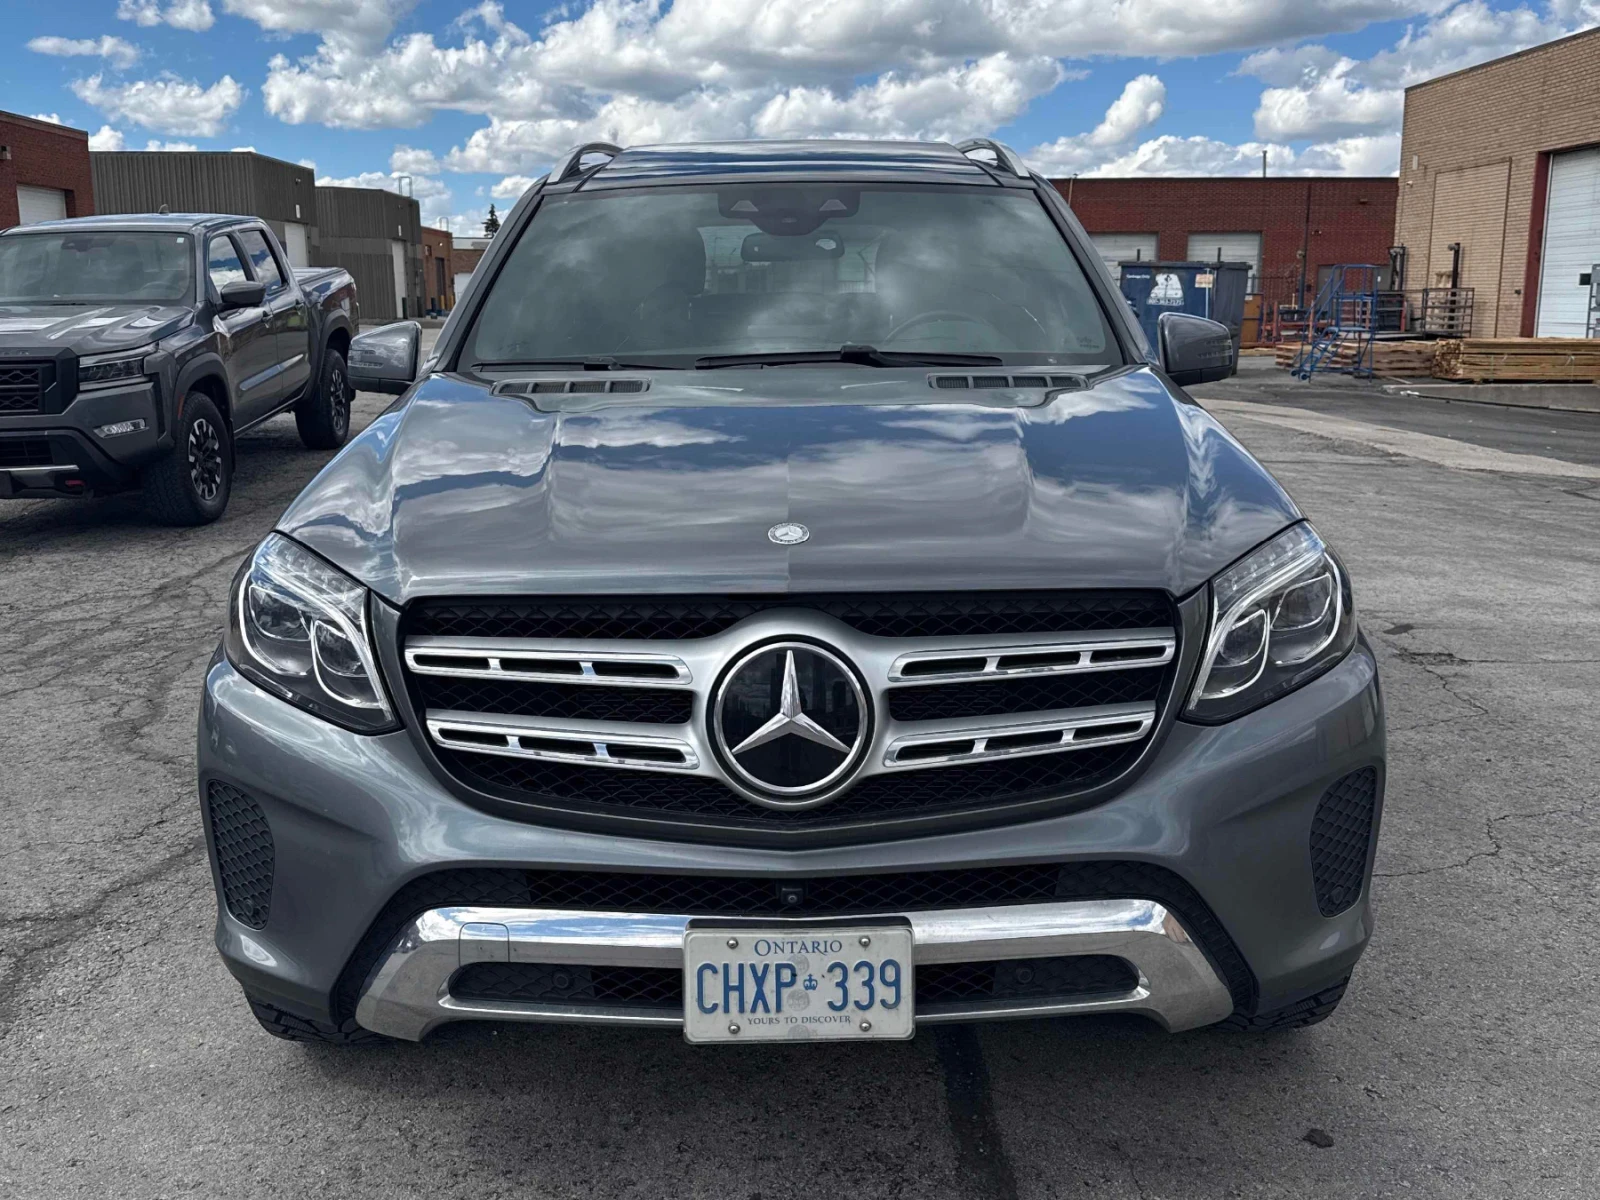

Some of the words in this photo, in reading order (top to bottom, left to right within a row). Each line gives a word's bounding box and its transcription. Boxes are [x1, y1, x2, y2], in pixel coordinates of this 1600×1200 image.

[754, 939, 843, 957] ONTARIO
[696, 962, 797, 1014] CHXP
[827, 958, 902, 1012] 339
[747, 1017, 780, 1025] YOURS
[784, 1016, 798, 1024] TO
[801, 1015, 851, 1025] DISCOVER
